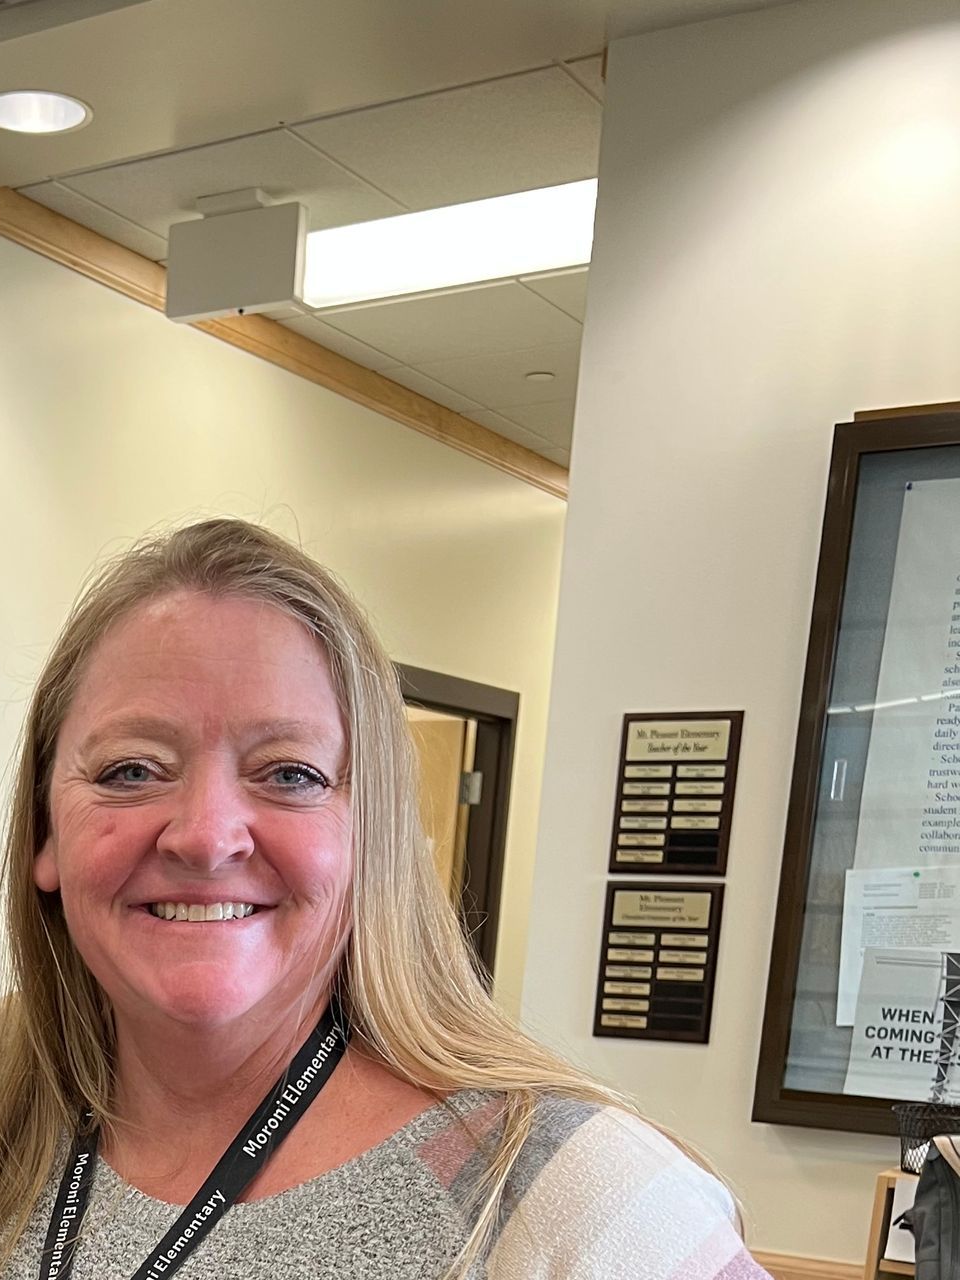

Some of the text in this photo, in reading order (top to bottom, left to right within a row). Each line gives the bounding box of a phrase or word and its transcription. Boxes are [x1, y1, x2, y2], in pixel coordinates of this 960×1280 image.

[934, 729, 958, 740] daily
[882, 1007, 935, 1024] WHEN
[865, 1026, 935, 1044] COMING
[871, 1046, 934, 1064] AT THE
[242, 1024, 342, 1158] Moroni Elementary
[66, 1153, 90, 1211] Moroni
[154, 1189, 227, 1275] Elementary
